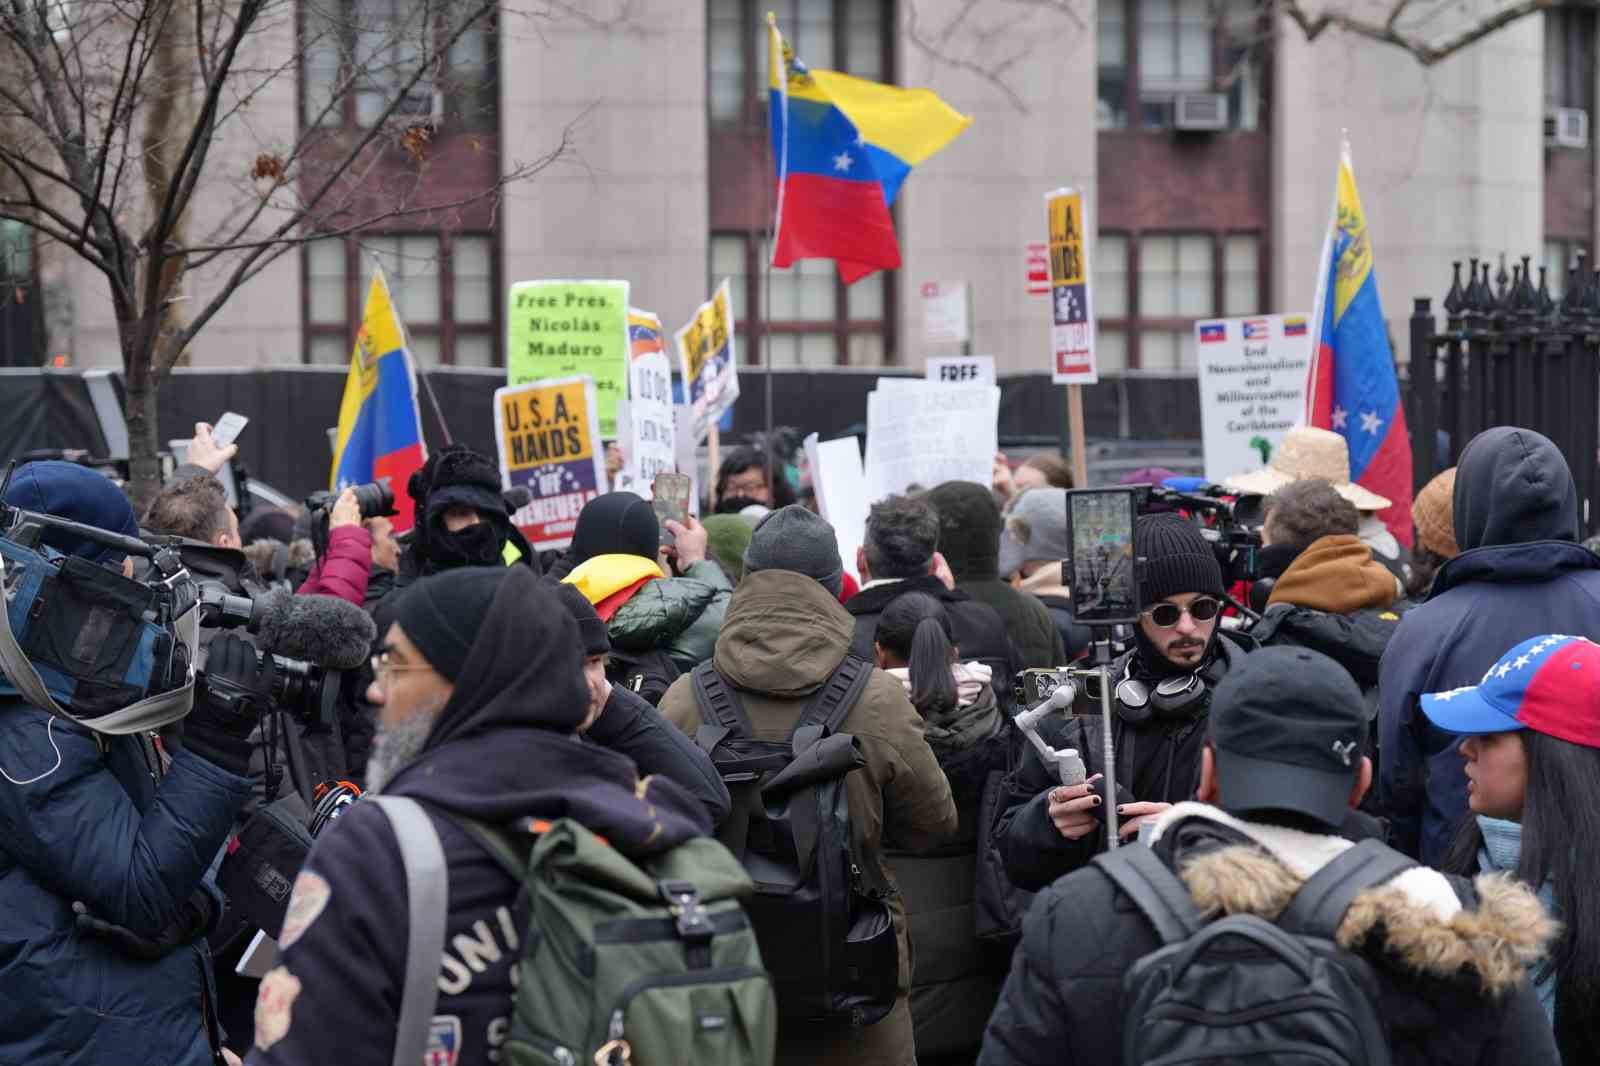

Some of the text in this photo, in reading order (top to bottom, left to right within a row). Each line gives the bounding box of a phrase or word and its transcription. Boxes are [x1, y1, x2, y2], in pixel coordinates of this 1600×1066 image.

[516, 292, 614, 308] Free Pres.
[528, 317, 602, 333] Nicolás
[527, 342, 603, 356] Maduro
[1244, 346, 1268, 357] End
[506, 393, 579, 432] U.S.A.
[511, 426, 581, 464] HANDS
[437, 906, 519, 996] UNI
